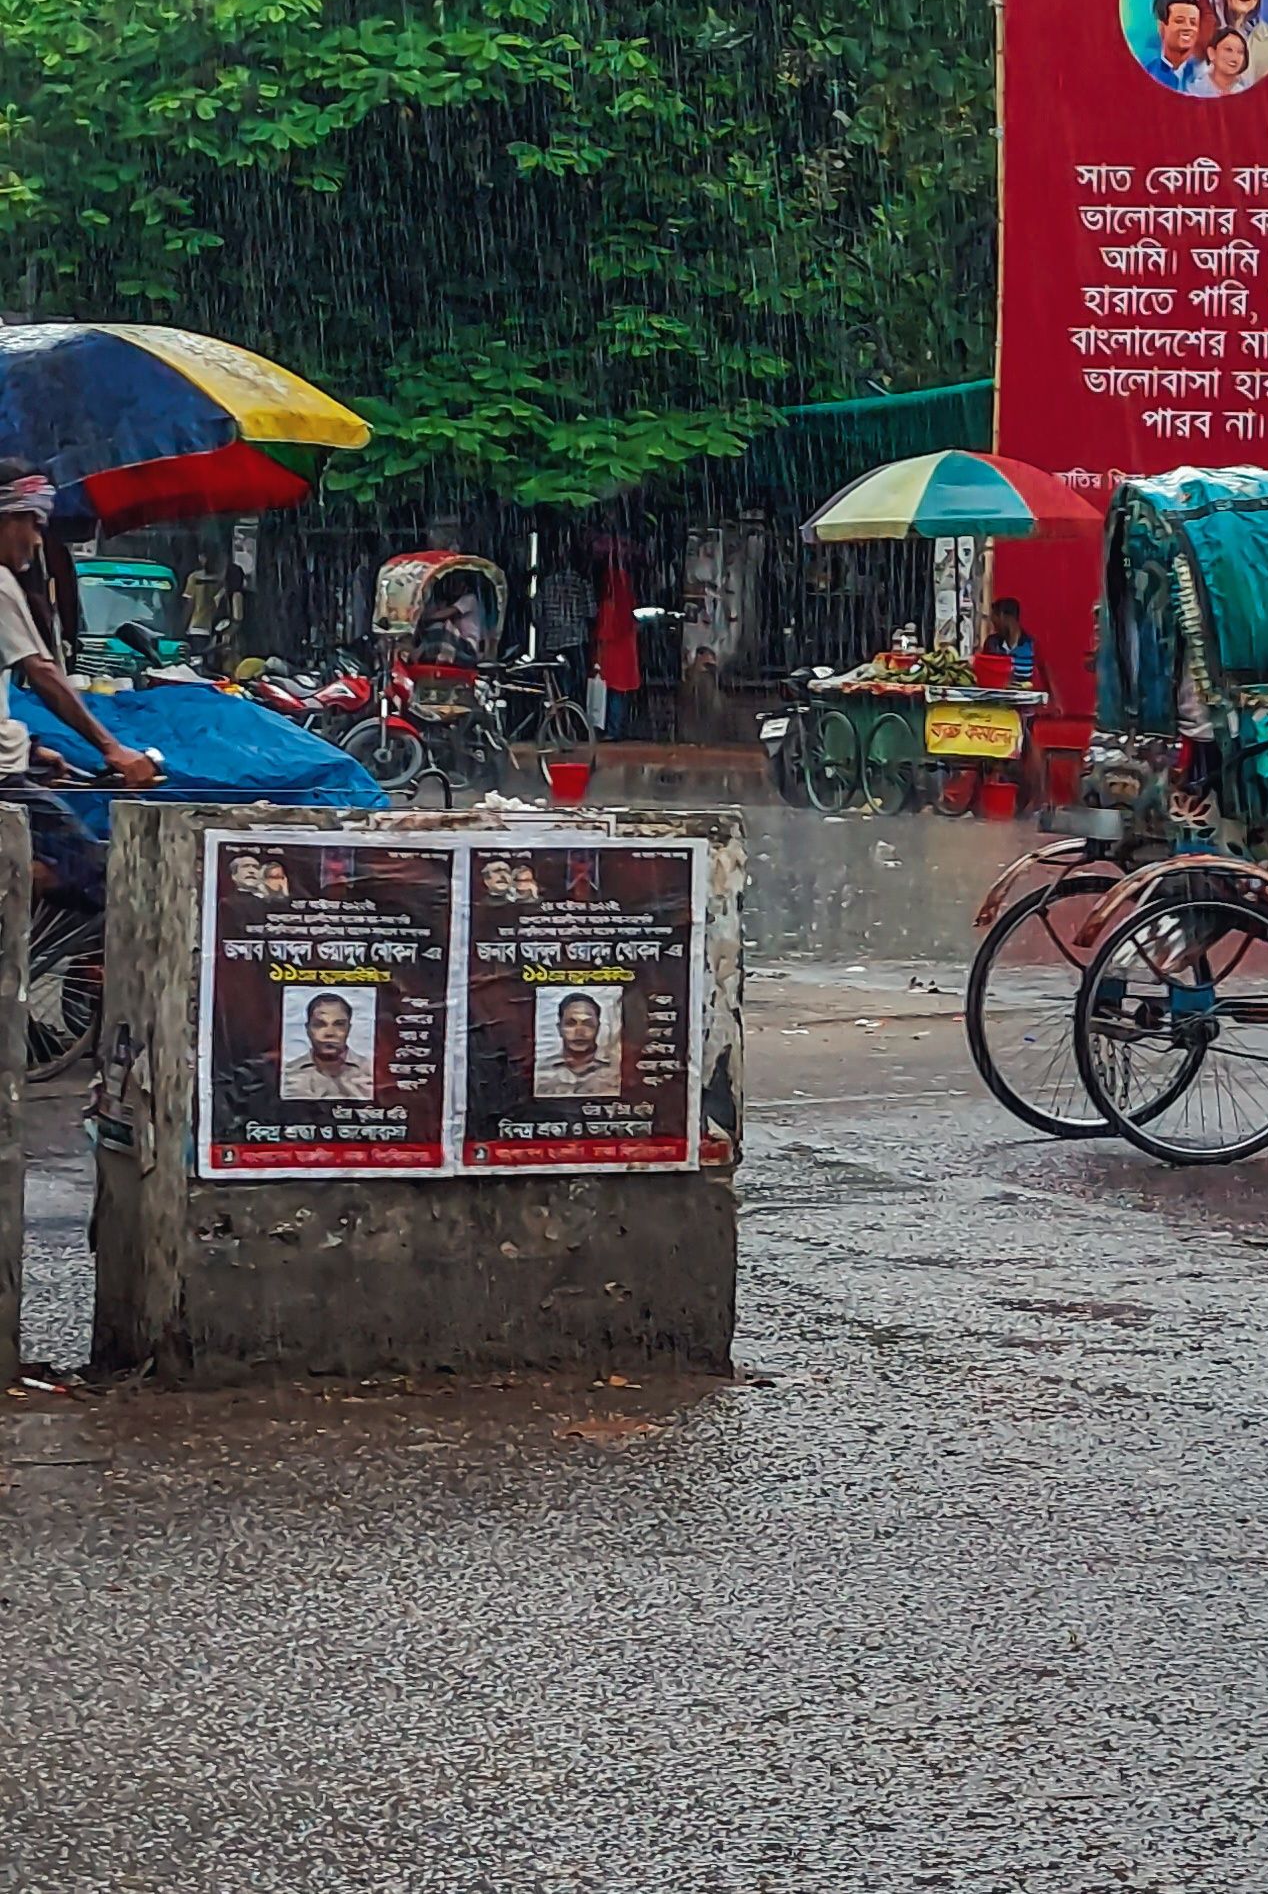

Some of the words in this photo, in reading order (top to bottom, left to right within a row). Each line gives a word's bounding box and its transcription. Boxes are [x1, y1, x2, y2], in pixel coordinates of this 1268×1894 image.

[1075, 163, 1136, 194] সাত
[1146, 157, 1222, 195] কোটি
[1079, 204, 1237, 236] ভালোবাসার
[1099, 237, 1177, 276] আমি।
[1190, 239, 1260, 277] আমি
[1081, 284, 1178, 316] হারাতে
[1188, 279, 1258, 325] পারি,
[1067, 325, 1228, 358] বাংলাদেশের
[1082, 365, 1222, 398] ভালোবাসা
[1141, 407, 1213, 438] পারব
[1223, 407, 1266, 440] না।
